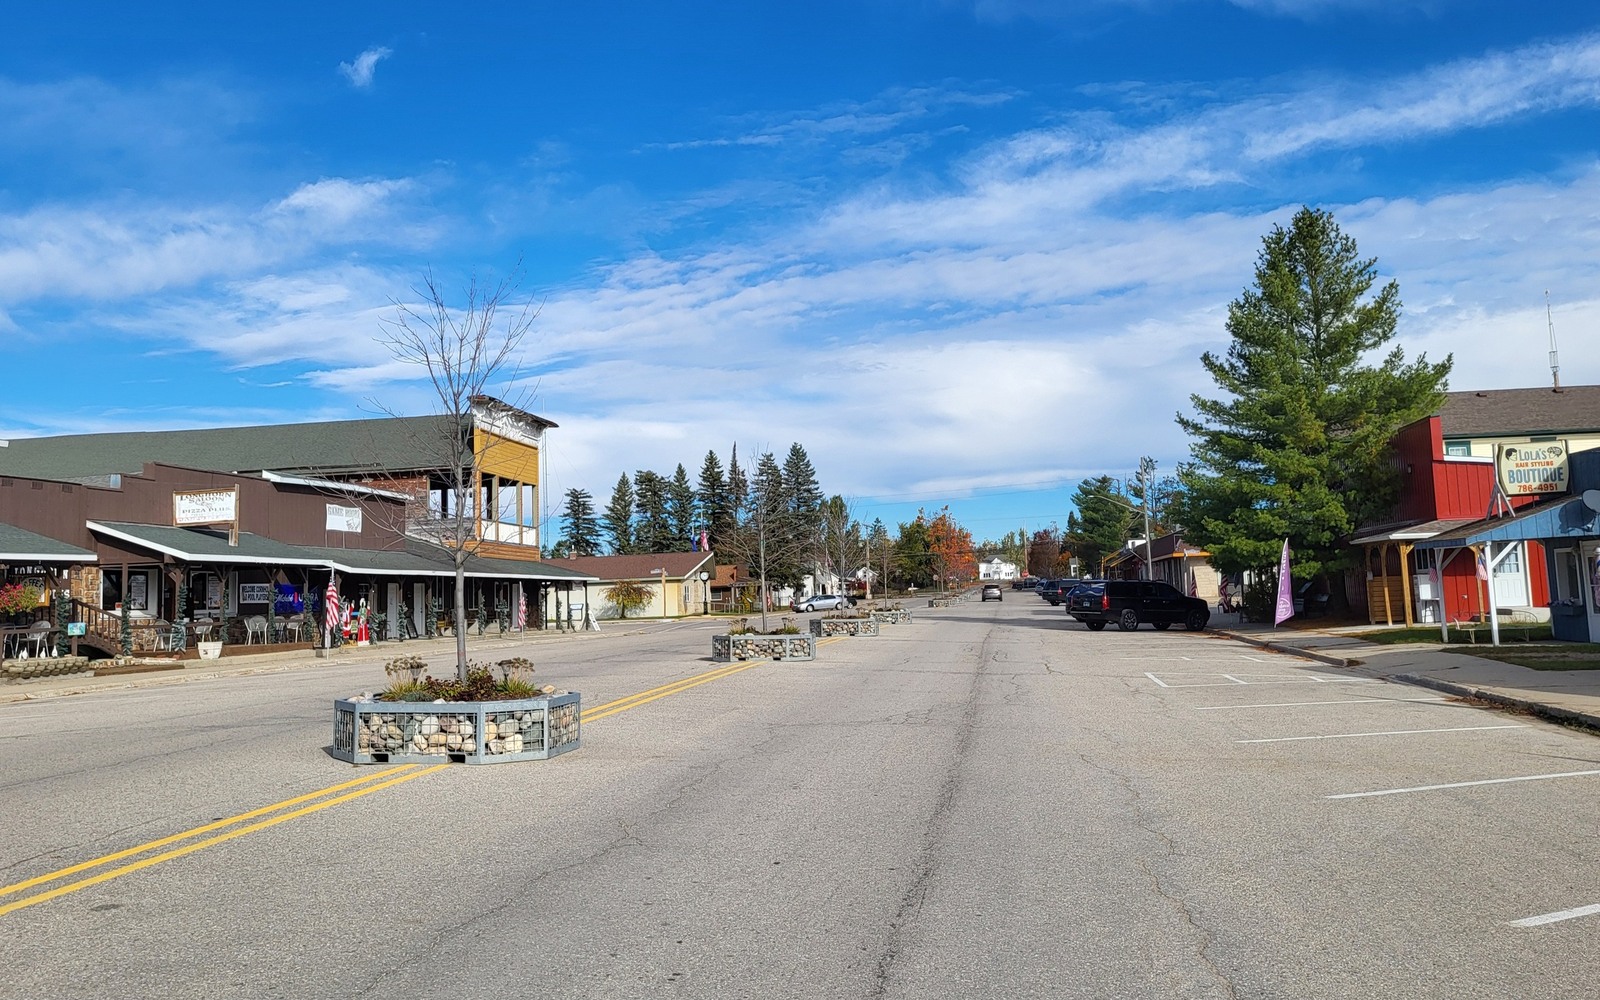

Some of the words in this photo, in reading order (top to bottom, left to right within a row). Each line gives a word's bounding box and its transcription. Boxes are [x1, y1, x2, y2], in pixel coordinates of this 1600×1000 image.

[1518, 448, 1547, 461] LOLA'S
[1508, 467, 1564, 484] BOUTIQUE
[1517, 483, 1558, 492] 786-4951
